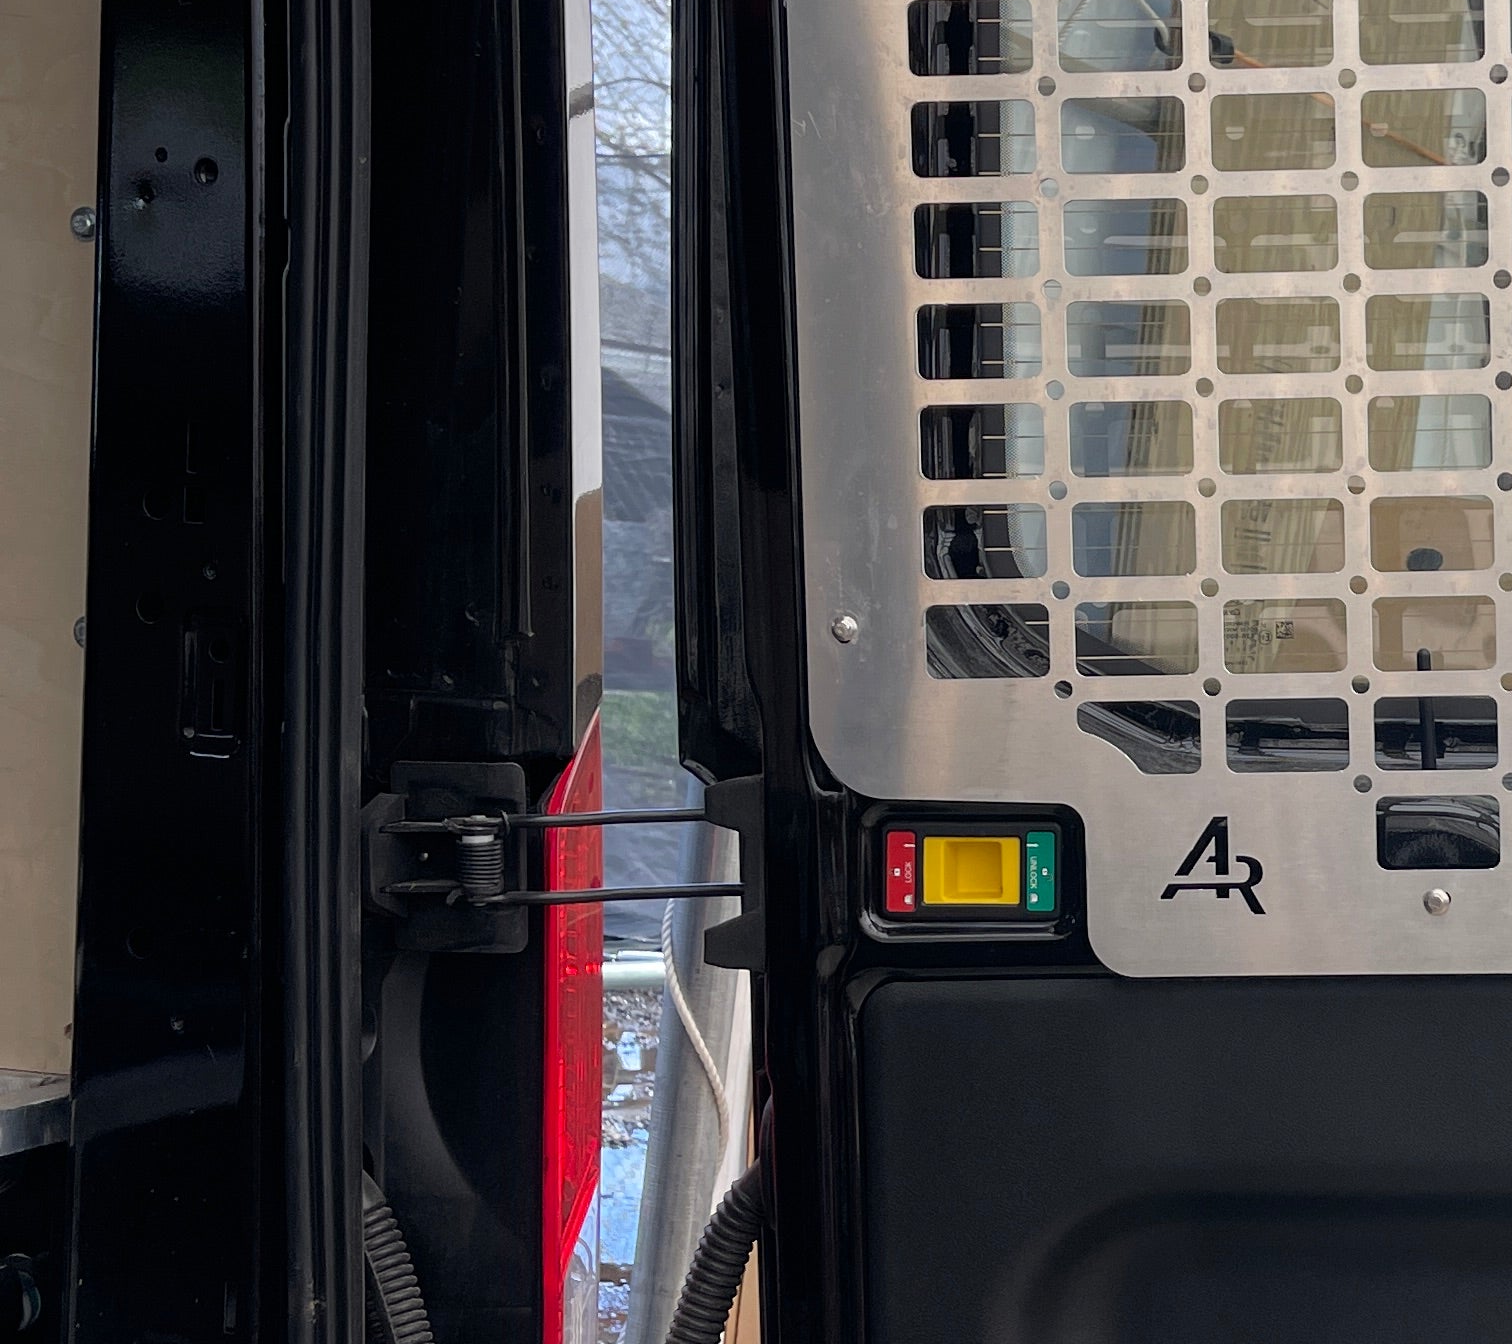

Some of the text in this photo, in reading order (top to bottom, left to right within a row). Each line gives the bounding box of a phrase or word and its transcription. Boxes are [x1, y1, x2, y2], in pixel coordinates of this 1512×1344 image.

[904, 861, 913, 884] LOCK
[1029, 856, 1038, 890] UNLOCK
[1160, 816, 1266, 915] AR
